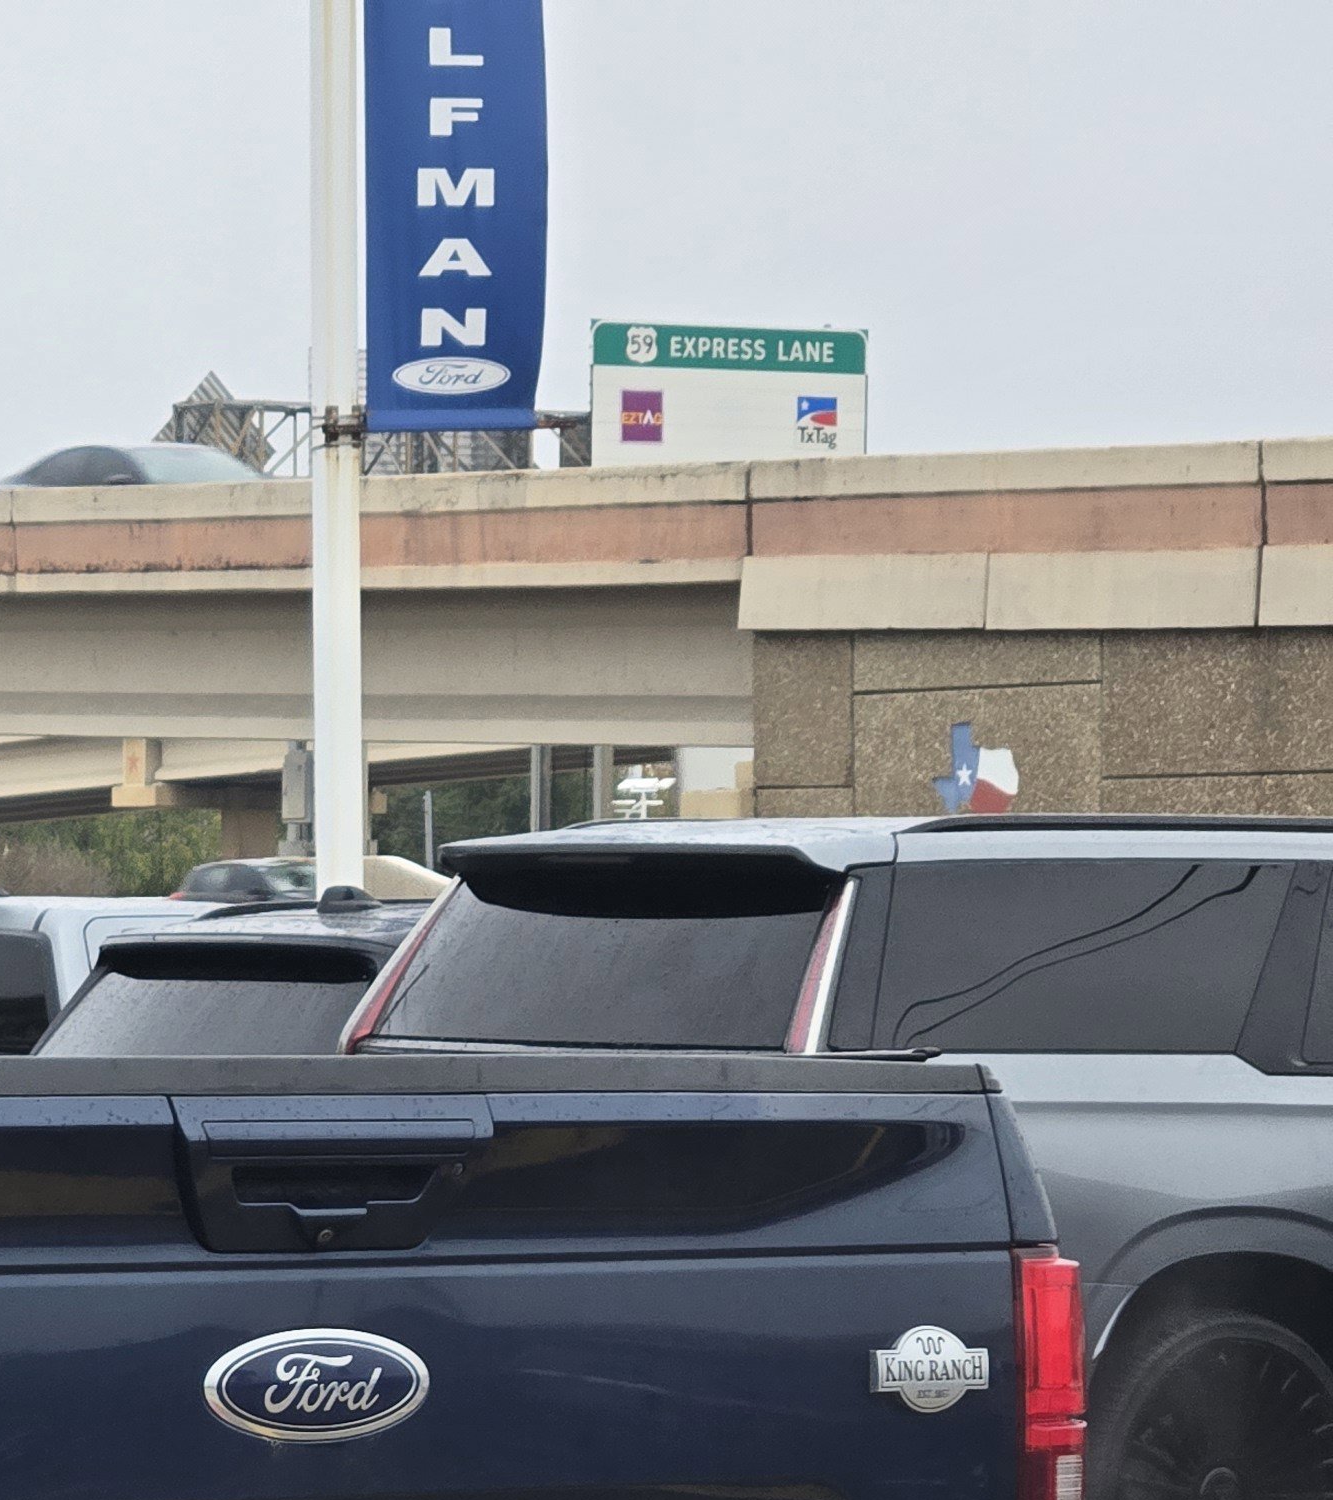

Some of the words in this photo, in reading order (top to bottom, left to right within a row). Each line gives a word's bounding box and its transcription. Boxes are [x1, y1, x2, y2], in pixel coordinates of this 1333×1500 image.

[630, 334, 654, 354] 59
[670, 336, 766, 360] EXPRESS
[778, 340, 834, 362] LANE
[418, 363, 484, 386] Ford
[797, 427, 837, 449] TxTag
[884, 1357, 925, 1382] KING
[929, 1356, 983, 1381] RANCH
[264, 1352, 383, 1414] Ford
